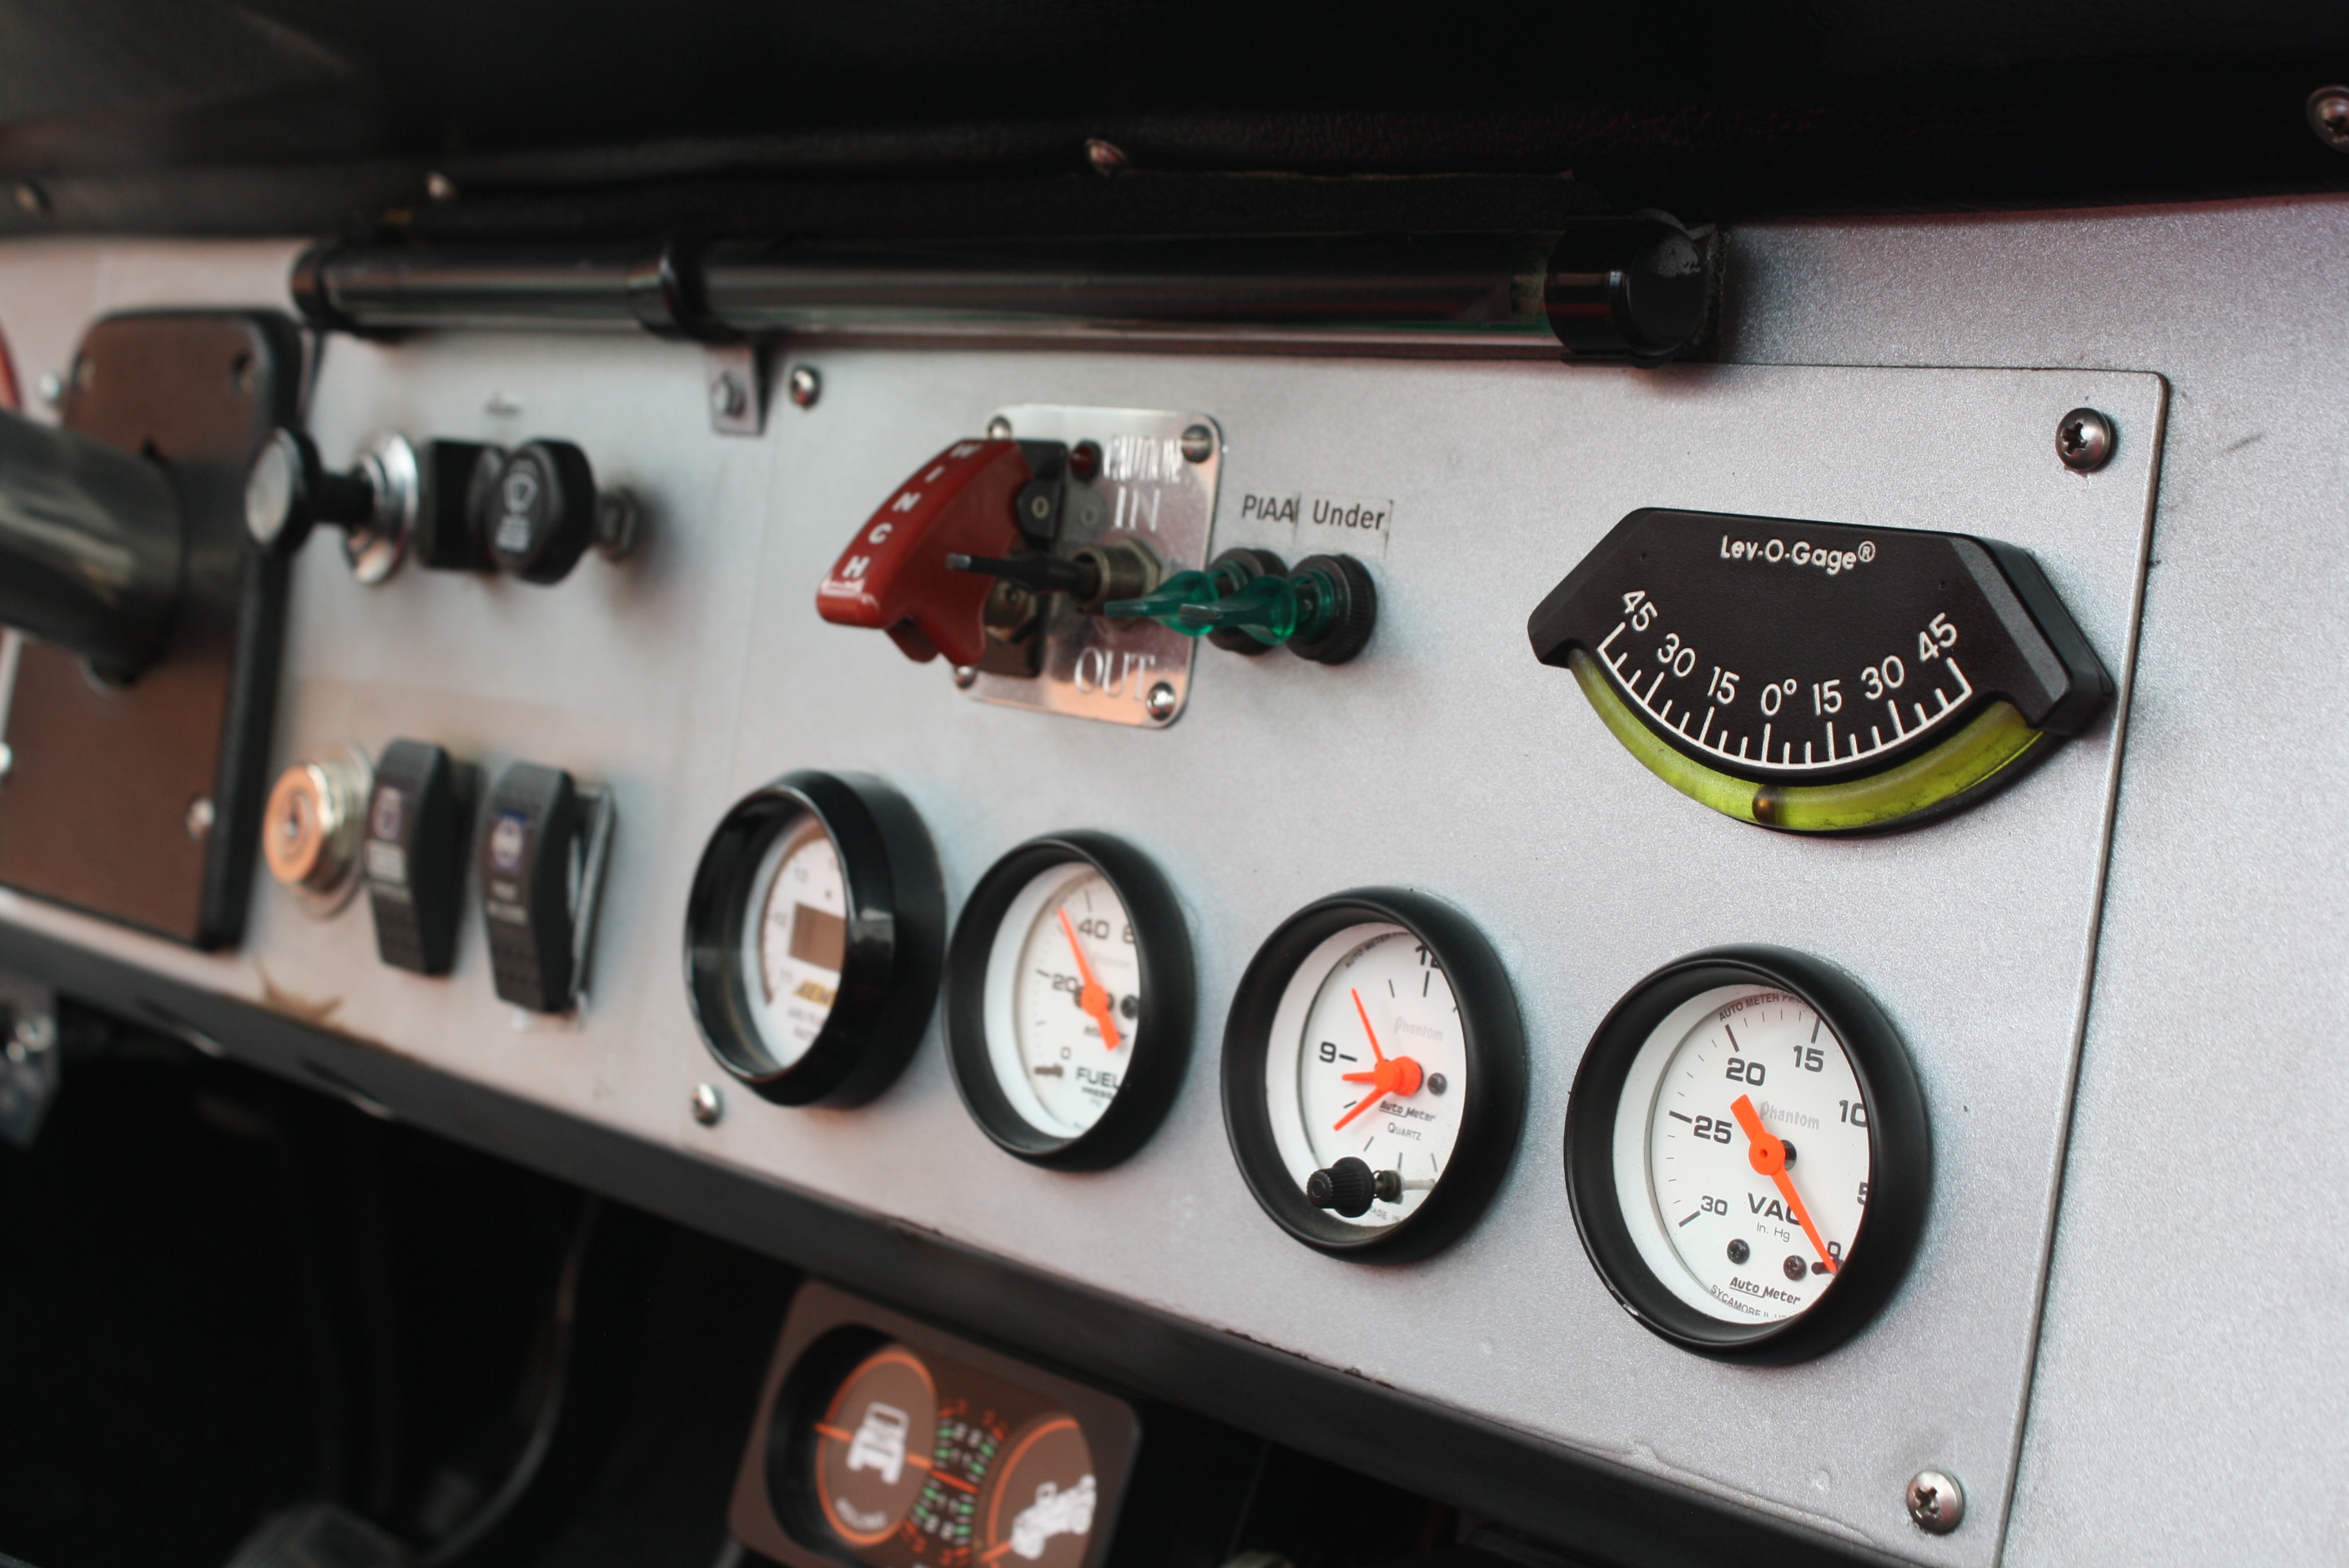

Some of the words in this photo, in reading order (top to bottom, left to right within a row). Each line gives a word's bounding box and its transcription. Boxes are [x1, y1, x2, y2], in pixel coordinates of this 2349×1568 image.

[841, 443, 983, 579] WINCH
[1240, 494, 1294, 523] PIAA
[1312, 499, 1386, 530] Under
[1622, 590, 1658, 631] 45
[1657, 632, 1696, 677] 30
[1707, 666, 1740, 705] 15
[1812, 678, 1843, 716] 15
[1860, 655, 1905, 701] 30
[1919, 612, 1959, 663] 45
[1074, 646, 1156, 701] OUT
[1078, 918, 1110, 941] 40
[1053, 973, 1079, 993] 20
[1718, 1002, 1744, 1023] AUTO
[1745, 993, 1780, 1009] METER
[1319, 1042, 1336, 1063] 9
[1793, 1045, 1825, 1073] 15
[1075, 1067, 1119, 1088] FUEL
[1725, 1057, 1767, 1087] 20
[1380, 1099, 1404, 1116] Auto
[1406, 1106, 1436, 1123] Meter
[1758, 1099, 1821, 1131] Phantom
[1838, 1099, 1869, 1128] 10
[1693, 1114, 1733, 1145] 25
[1700, 1194, 1729, 1217] 30
[1756, 1222, 1769, 1235] In.
[1774, 1226, 1791, 1244] Hg
[1827, 1240, 1842, 1259] 0
[1729, 1276, 1761, 1294] Auto
[1763, 1285, 1802, 1305] Meter
